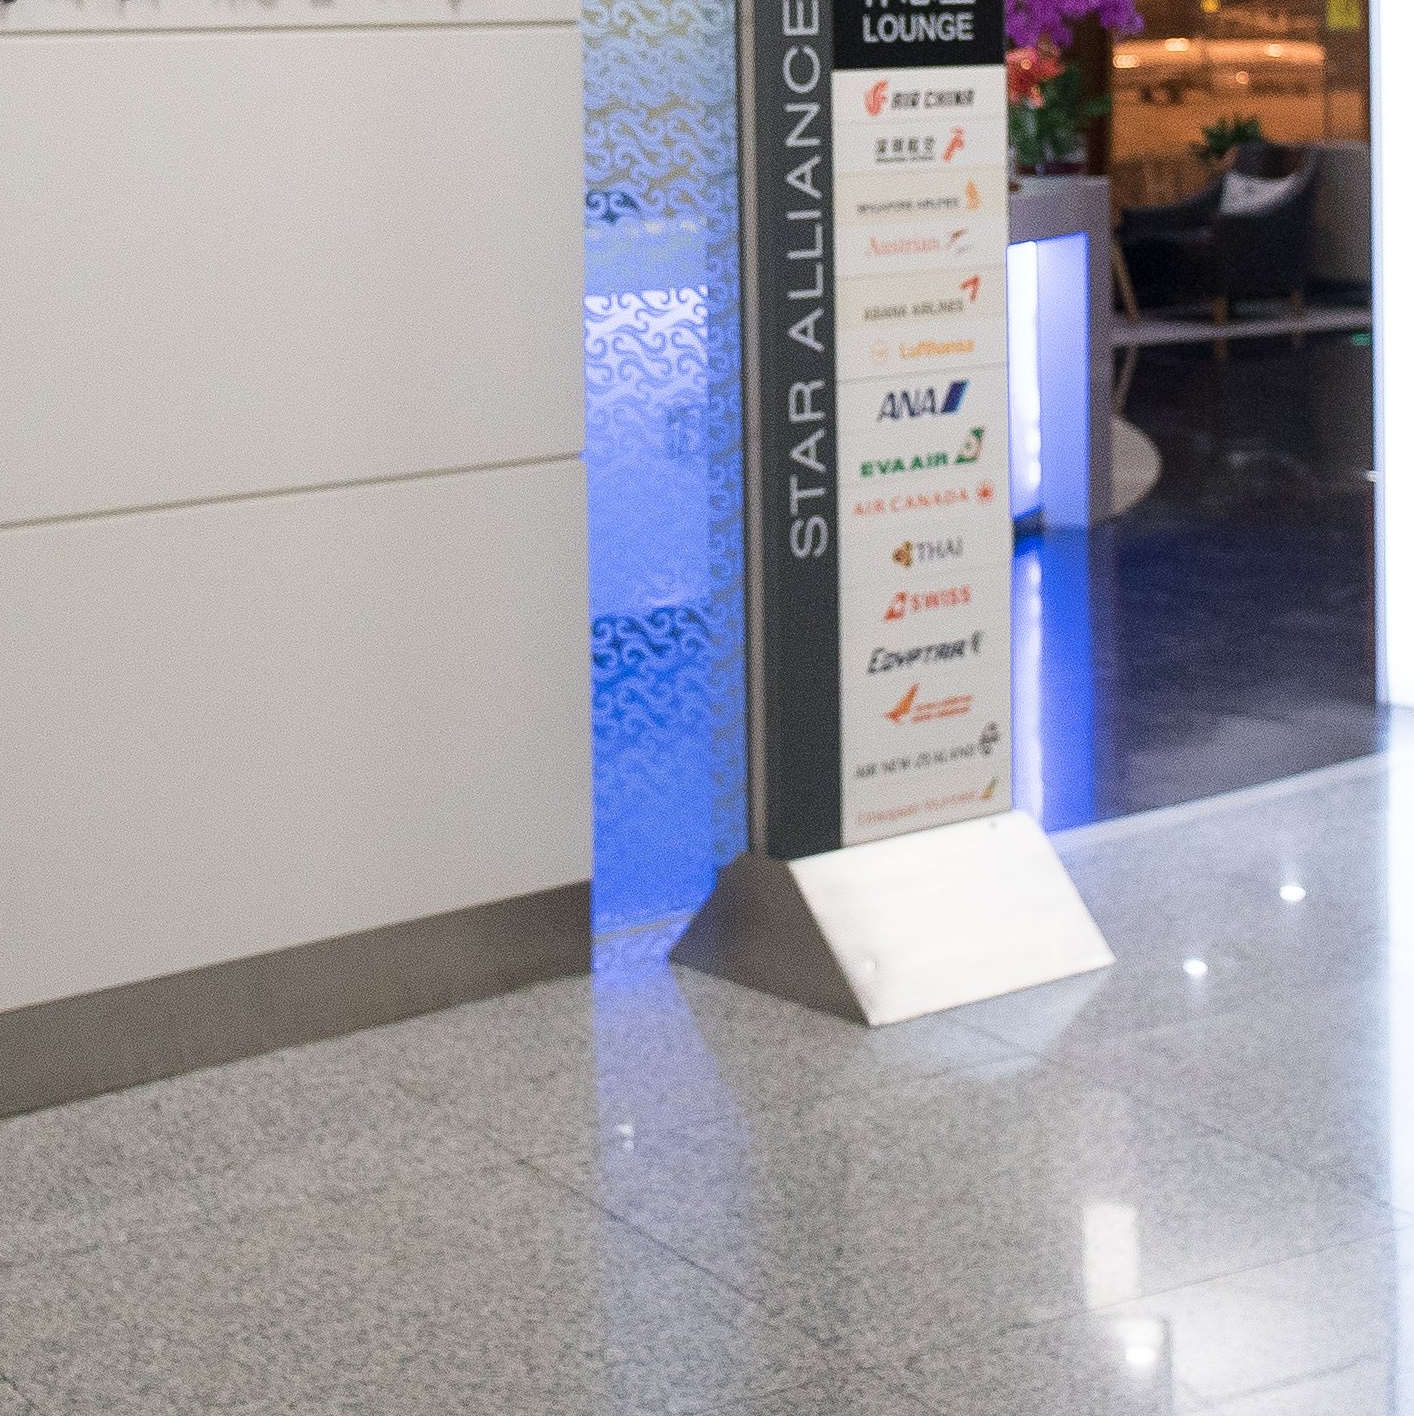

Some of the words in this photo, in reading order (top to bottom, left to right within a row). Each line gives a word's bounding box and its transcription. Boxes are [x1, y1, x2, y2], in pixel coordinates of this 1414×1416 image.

[861, 11, 976, 44] LOUNGE
[891, 91, 920, 110] AIR
[923, 88, 976, 109] CHINA
[898, 338, 975, 361] Lufthansa
[876, 386, 939, 423] ANA
[788, 379, 830, 559] STAR
[852, 498, 886, 517] AIR
[889, 487, 970, 514] CANADA
[916, 536, 964, 563] THAI
[910, 585, 973, 614] SWISS
